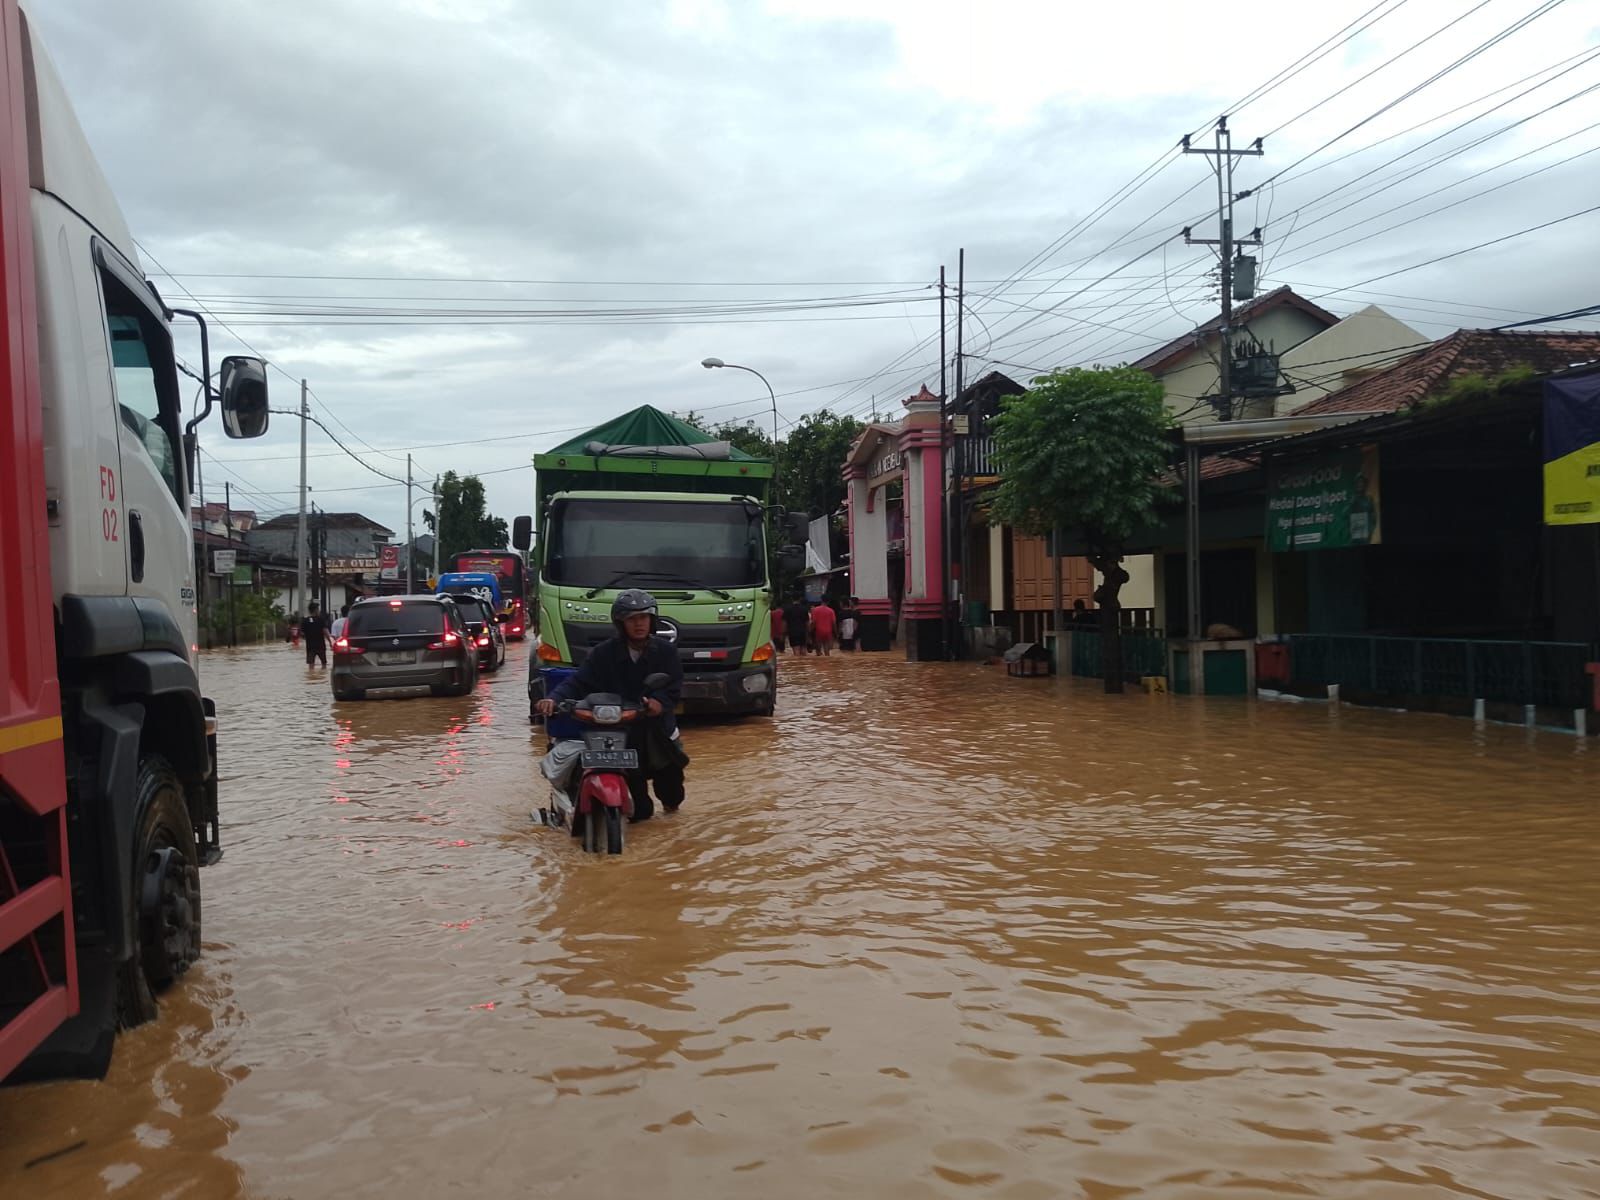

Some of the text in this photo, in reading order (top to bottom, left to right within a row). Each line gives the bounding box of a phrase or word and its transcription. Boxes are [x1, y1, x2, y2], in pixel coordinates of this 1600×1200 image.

[100, 465, 115, 501] FD
[103, 508, 118, 541] 02
[350, 559, 379, 568] OVEN
[568, 613, 609, 621] HINO
